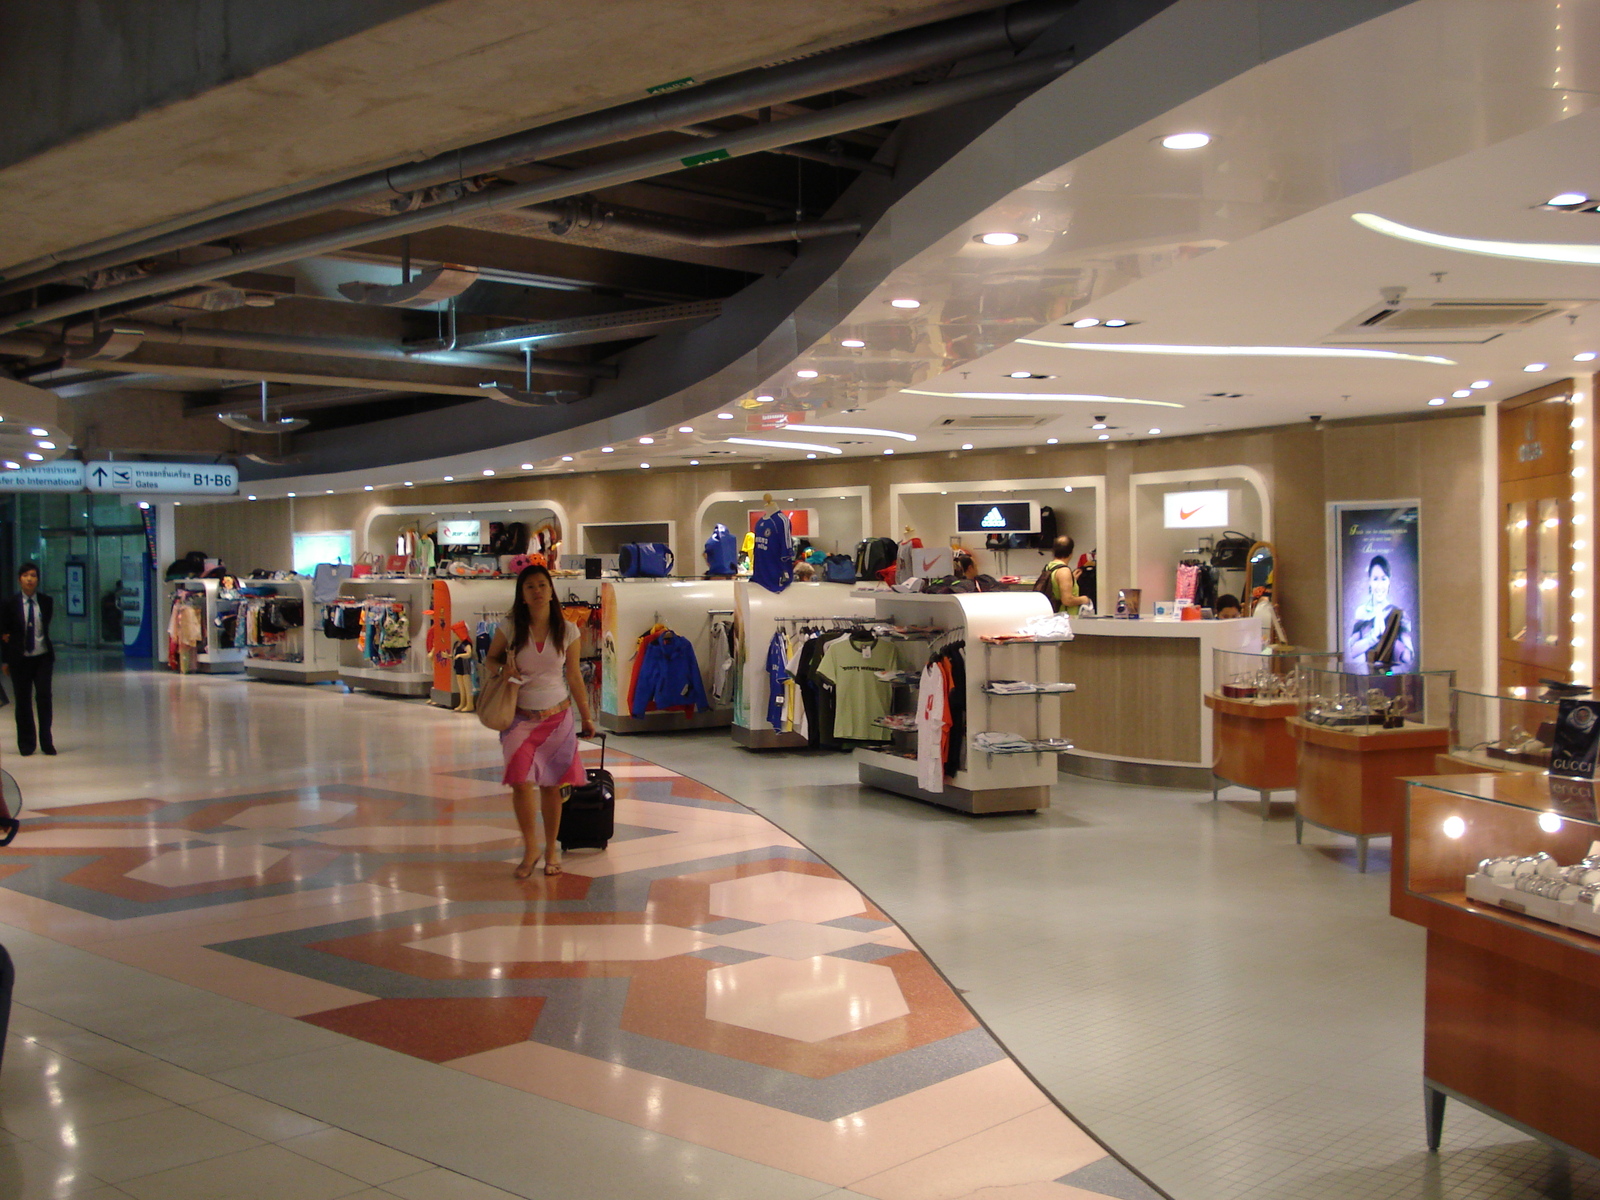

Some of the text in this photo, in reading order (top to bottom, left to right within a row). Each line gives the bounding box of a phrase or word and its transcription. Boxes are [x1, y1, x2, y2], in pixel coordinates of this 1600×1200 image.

[16, 477, 25, 485] to
[27, 476, 82, 486] International
[135, 480, 158, 488] Gates
[193, 473, 232, 487] B1-B6
[1553, 758, 1593, 773] GUCCI
